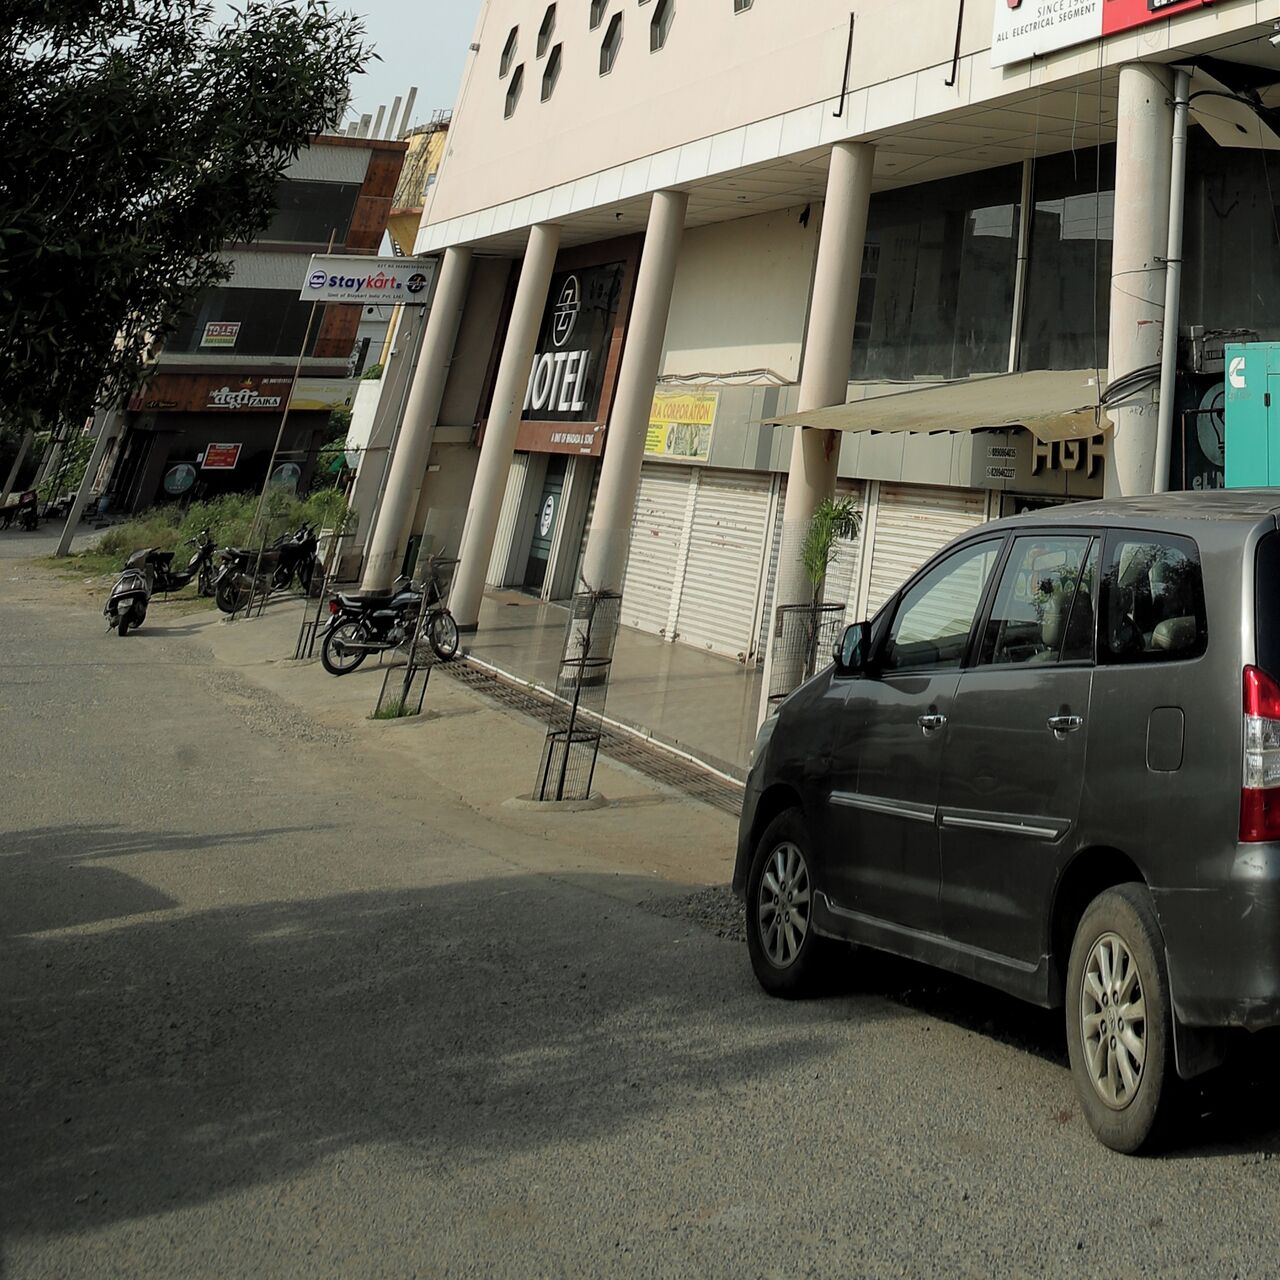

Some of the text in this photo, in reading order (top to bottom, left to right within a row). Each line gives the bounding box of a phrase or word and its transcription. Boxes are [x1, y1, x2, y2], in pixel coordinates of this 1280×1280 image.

[1037, 0, 1065, 18] SINCE
[996, 2, 1097, 43] ALL ELECTRICAL SEGMENT
[250, 396, 281, 408] ZAIKA
[664, 402, 711, 421] CORPORATION
